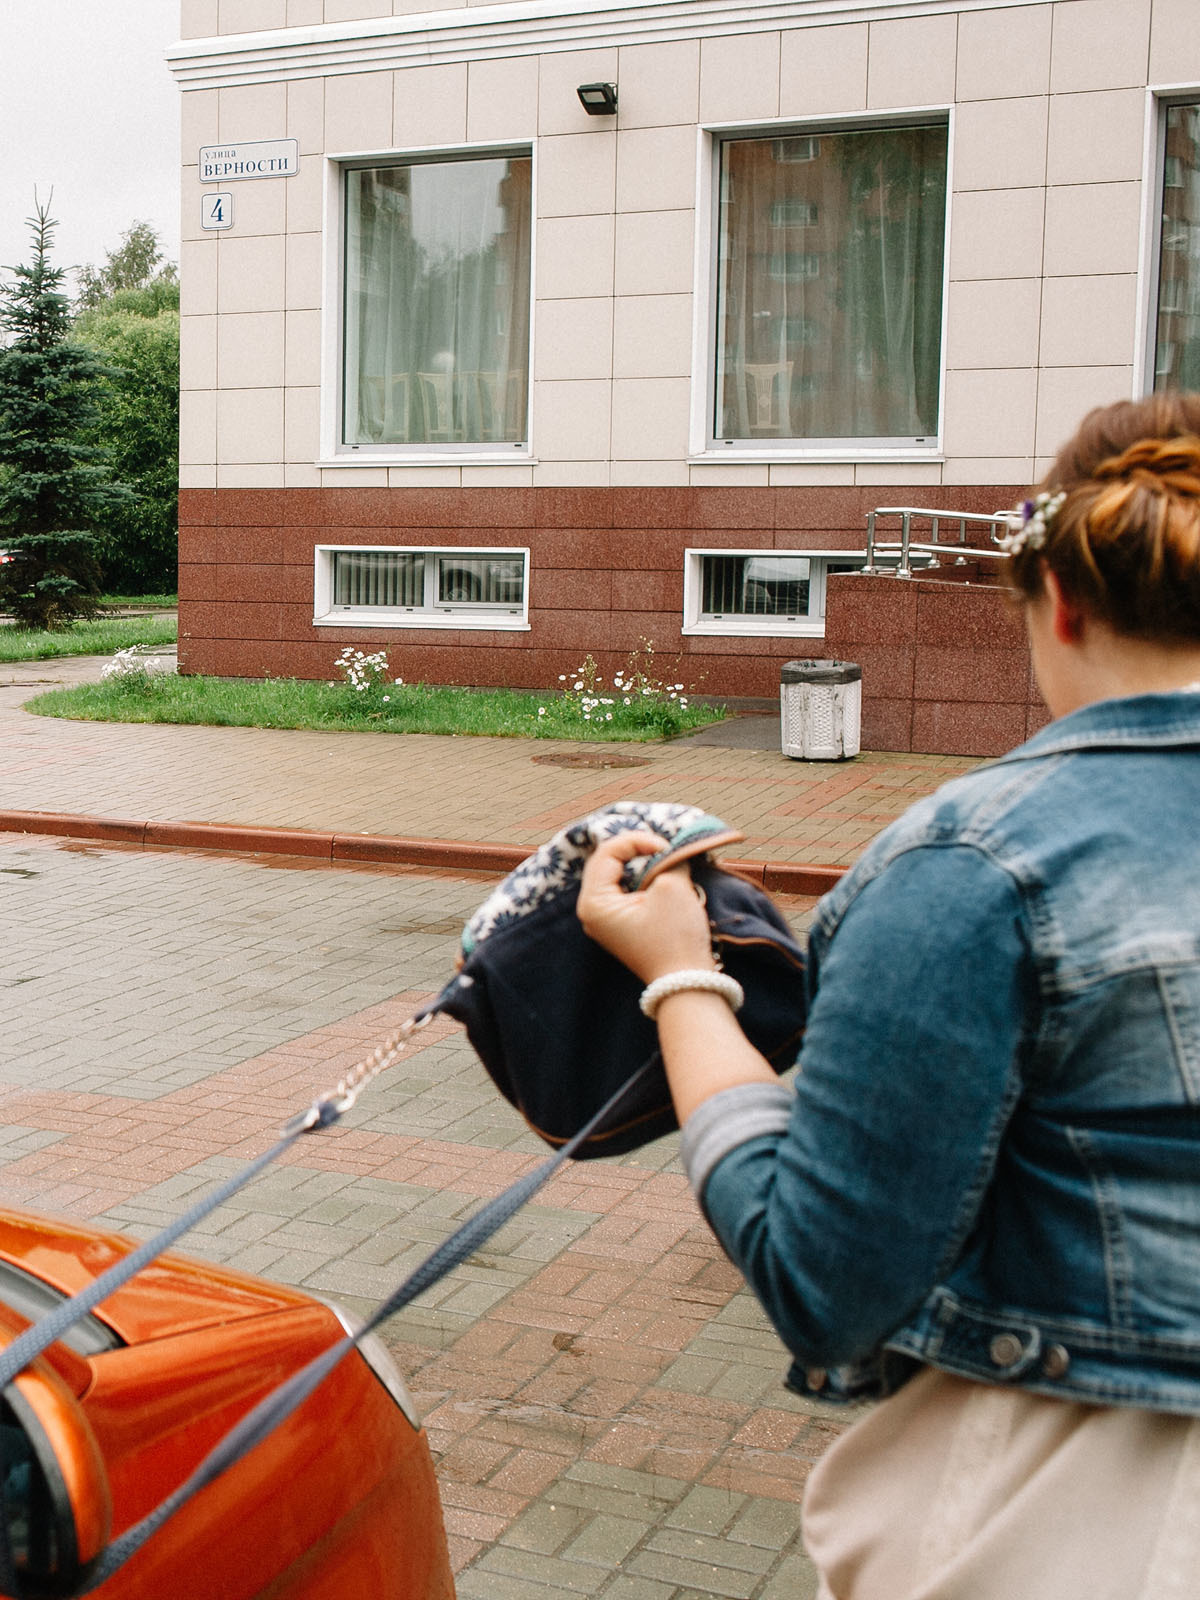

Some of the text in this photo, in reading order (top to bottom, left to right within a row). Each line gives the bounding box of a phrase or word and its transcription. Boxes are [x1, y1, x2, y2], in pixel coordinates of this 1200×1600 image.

[205, 150, 236, 160] улица
[204, 158, 288, 176] ВЕРНОСТИ
[210, 198, 224, 222] 4
